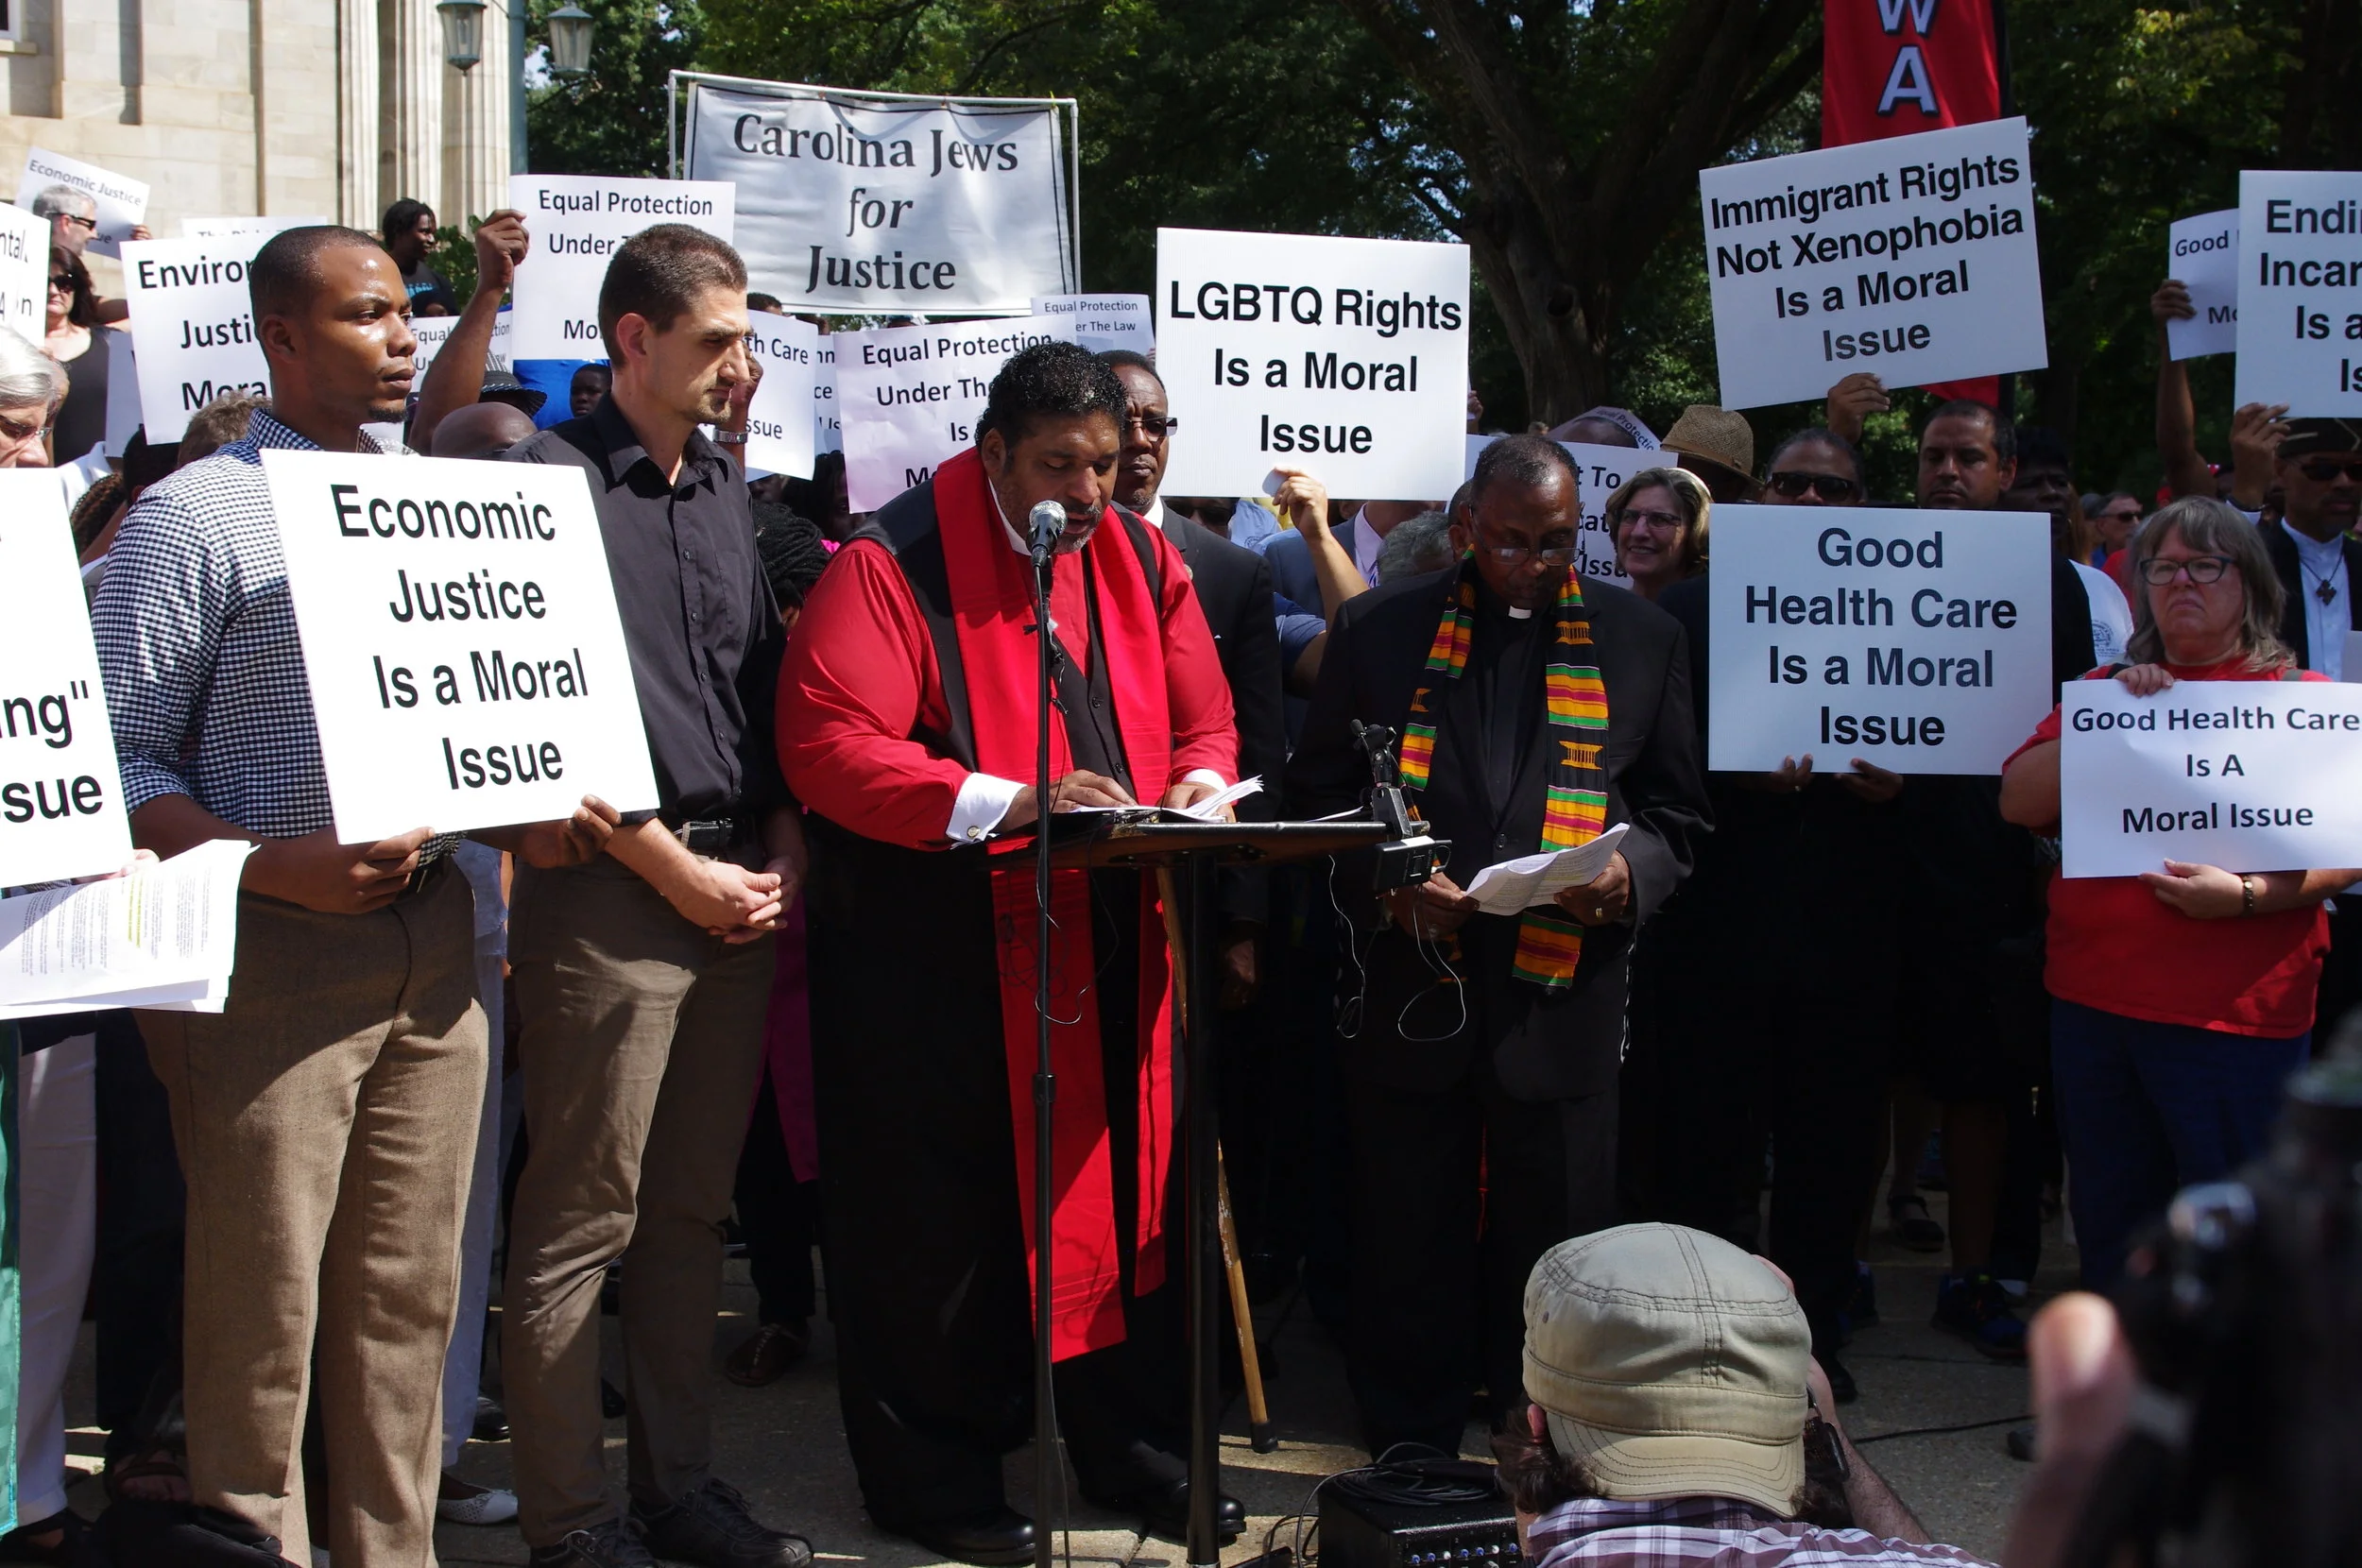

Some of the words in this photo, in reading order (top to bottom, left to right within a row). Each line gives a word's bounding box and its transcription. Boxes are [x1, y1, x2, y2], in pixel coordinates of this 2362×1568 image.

[733, 113, 916, 168] Carolina
[930, 129, 1018, 178] Jews
[29, 160, 95, 191] Economic
[98, 182, 142, 206] Justice
[1711, 173, 1891, 230] Immigrant
[1900, 155, 2020, 202] Rights
[539, 190, 600, 215] Equal
[608, 192, 712, 216] Protection
[847, 187, 914, 237] for
[2267, 199, 2362, 234] Endi
[549, 233, 615, 254] Under
[1716, 240, 1782, 278] Not
[1791, 203, 2024, 266] Xenophobia
[2175, 230, 2229, 256] Good
[805, 245, 956, 294] Justice
[2260, 252, 2362, 287] Incar
[1044, 301, 1077, 314] Equal
[1080, 300, 1138, 311] Protection
[1775, 287, 1809, 318] Is
[1823, 286, 1844, 312] a
[1857, 260, 1969, 307] Moral
[1089, 321, 1110, 331] The
[1114, 321, 1136, 331] Law
[1171, 281, 1323, 326] LGBTQ
[1335, 288, 1462, 338] Rights
[2296, 305, 2330, 339] Is
[180, 314, 251, 349] Justi
[1823, 323, 1931, 362] Issue
[771, 338, 809, 365] Care
[863, 338, 929, 367] Equal
[1214, 348, 1250, 387] Is
[1265, 359, 1288, 388] a
[1304, 351, 1418, 392] Moral
[877, 382, 951, 406] Under
[958, 377, 992, 398] Th
[745, 418, 782, 439] ssue
[950, 422, 968, 441] Is
[1260, 414, 1373, 454] Issue
[1591, 466, 1620, 488] To
[331, 484, 556, 541] Economic
[1581, 554, 1627, 578] Issu
[1817, 527, 1943, 568] Good
[389, 569, 546, 622] Justice
[1746, 586, 1893, 625] Health
[1911, 588, 2017, 628] Care
[372, 655, 419, 708] Is
[433, 663, 461, 706] a
[470, 648, 588, 702] Moral
[1770, 645, 1807, 685] Is
[1823, 656, 1849, 685] a
[1867, 647, 1993, 687] Moral
[1821, 706, 1945, 746] Issue
[2072, 707, 2156, 732] Good
[2168, 707, 2274, 730] Health
[2286, 707, 2360, 730] Care
[441, 737, 563, 790] Issue
[2186, 754, 2211, 776] Is
[2221, 754, 2245, 776] A
[2123, 802, 2218, 833] Moral
[2230, 803, 2314, 827] Issue
